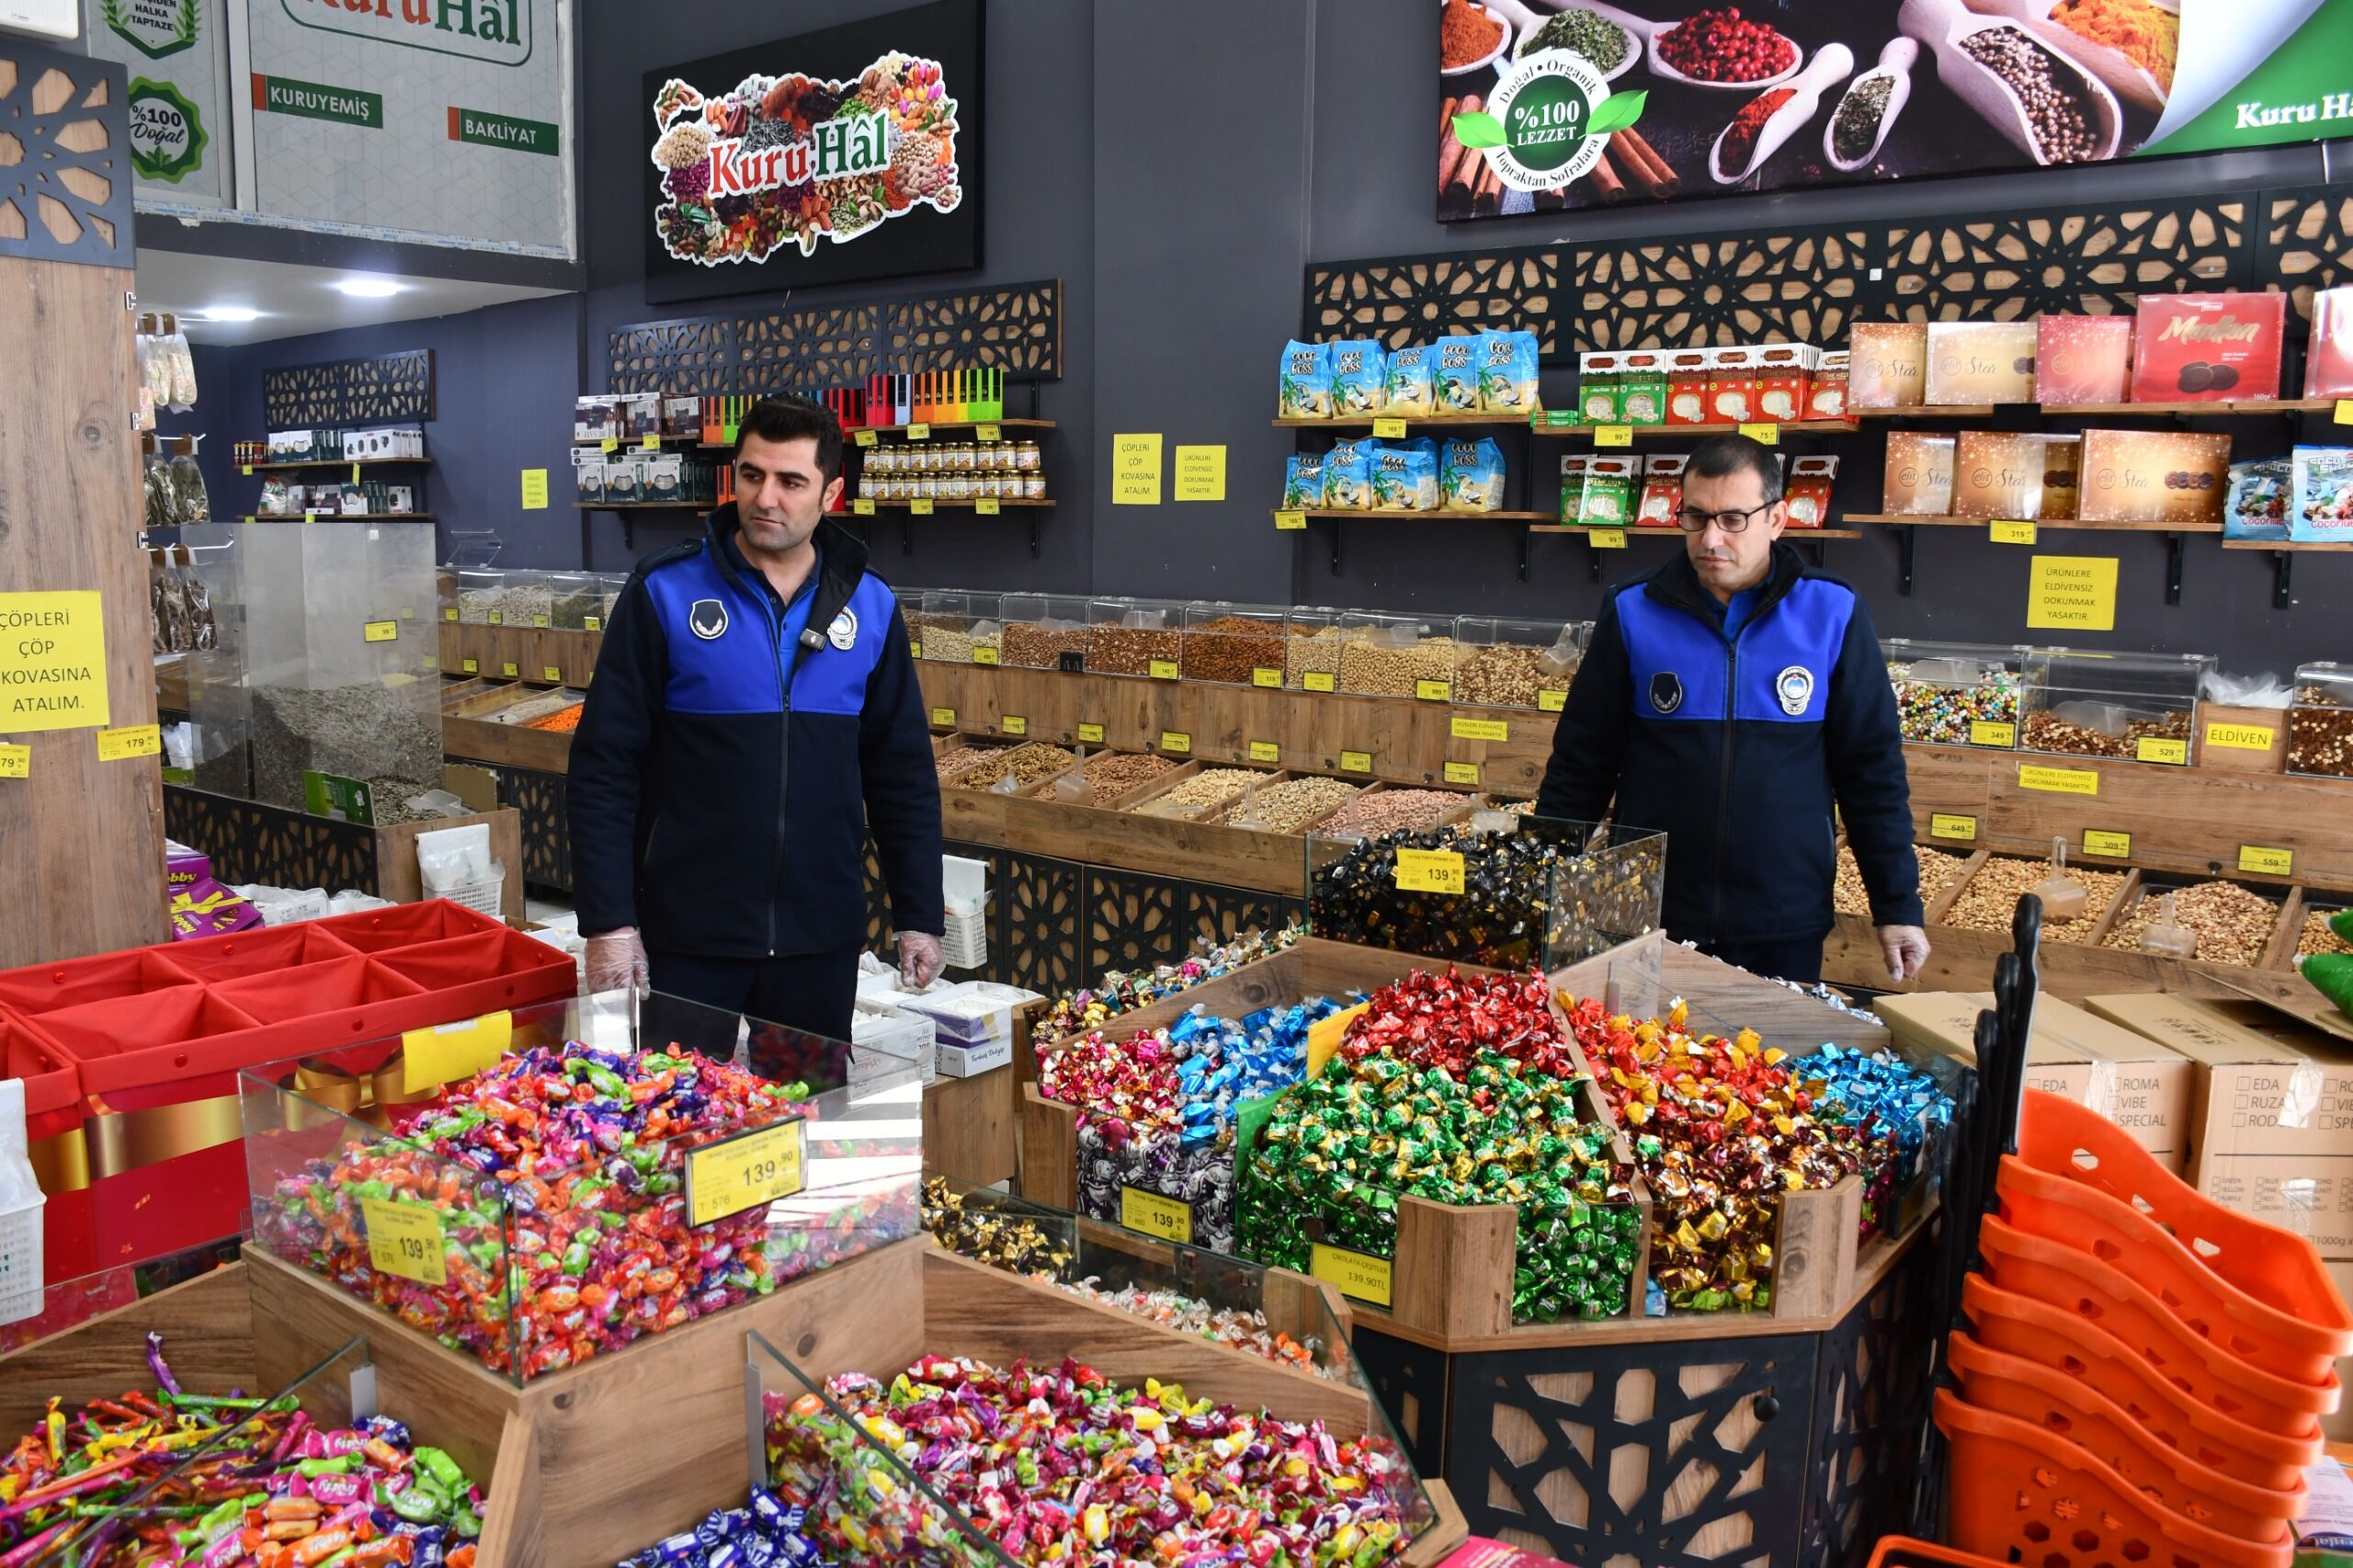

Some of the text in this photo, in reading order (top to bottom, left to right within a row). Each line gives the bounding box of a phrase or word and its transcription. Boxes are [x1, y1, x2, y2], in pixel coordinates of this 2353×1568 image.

[135, 4, 168, 18] HALKA
[131, 15, 175, 31] TAPTAZE
[1499, 59, 1597, 104] Doğal Organik
[270, 86, 369, 119] KURUYEMİŞ
[131, 106, 182, 127] %100
[1515, 99, 1580, 130] %100
[2234, 102, 2317, 129] Kuru
[131, 122, 186, 145] Doğal
[465, 119, 537, 144] BAKLİYAT
[1517, 126, 1577, 146] LEZZET
[710, 114, 889, 193] Kuru Hâl
[1495, 138, 1599, 187] Topraktan Sofralara
[1886, 358, 1918, 378] Star
[1121, 443, 1150, 453] ÇÖPLERİ
[1128, 458, 1142, 467] ÇÖP
[1120, 472, 1155, 481] KOVASINA
[1901, 467, 1954, 487] elit Star
[1974, 468, 2027, 487] elit Star
[2099, 469, 2148, 489] elit Star
[2046, 567, 2092, 578] ÜRÜNLERE
[2044, 582, 2094, 592] ELDİVENSİZ
[2043, 597, 2096, 607] DOKUNMAK
[0, 608, 70, 631] ÇÖPLERİ
[18, 639, 55, 658] ÇÖP
[1, 666, 92, 685] KOVASINA
[13, 695, 85, 713] ATALIM.
[1991, 731, 2005, 739] 349
[2211, 729, 2268, 745] ELDİVEN
[126, 738, 144, 748] 179
[2159, 748, 2175, 756] 529
[0, 757, 15, 767] 79
[2024, 767, 2092, 781] ÜRÜNLERE ELDİVENSİZ
[2023, 778, 2060, 787] DOKUNMAK
[2104, 841, 2119, 849] 309
[2263, 858, 2279, 867] 559
[169, 872, 197, 883] bby
[1427, 868, 1449, 881] 139
[2042, 1079, 2067, 1092] EDA
[2122, 1078, 2160, 1091] ROMA
[2253, 1077, 2279, 1091] EDA
[2339, 1081, 2353, 1093] RO
[2121, 1096, 2147, 1108] VIBE
[2119, 1113, 2166, 1127] SPECIAL
[2248, 1115, 2279, 1127] ROD
[743, 1160, 776, 1186] 139
[711, 1196, 731, 1210] 576
[1153, 1211, 1174, 1227] 139
[399, 1235, 424, 1259] 139
[2316, 1236, 2346, 1247] 1000g
[1332, 1253, 1360, 1266] ÇİKOLATA
[1347, 1271, 1386, 1290] 139.90TL
